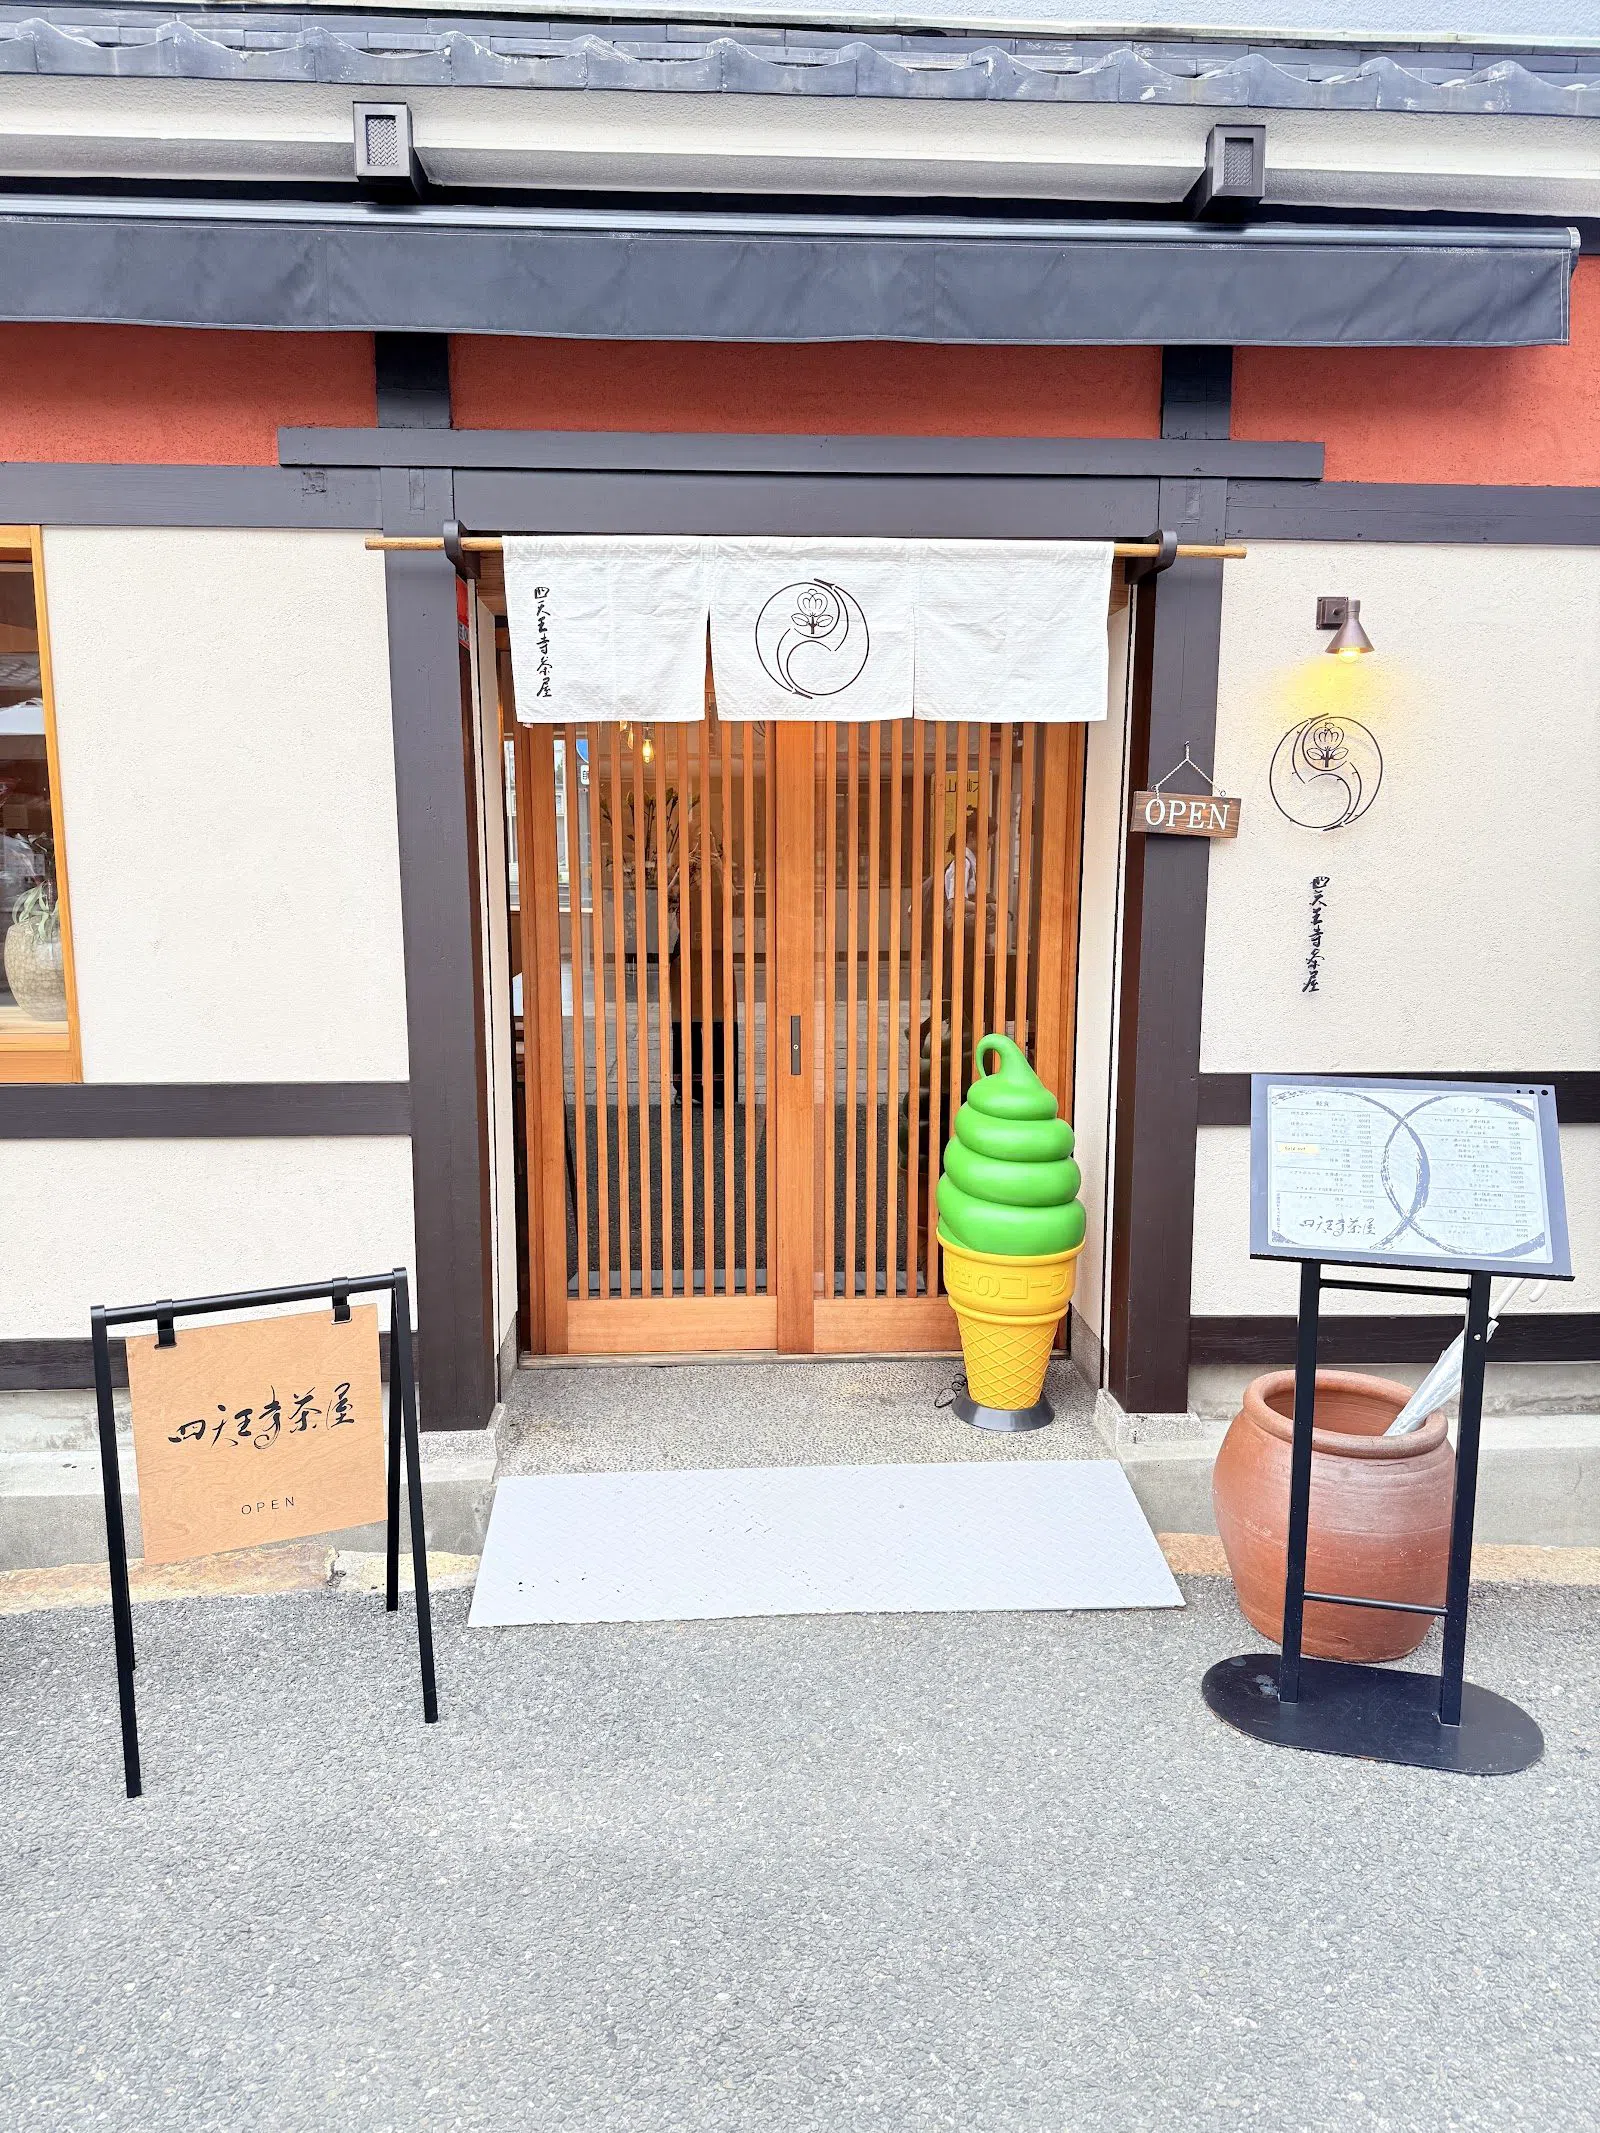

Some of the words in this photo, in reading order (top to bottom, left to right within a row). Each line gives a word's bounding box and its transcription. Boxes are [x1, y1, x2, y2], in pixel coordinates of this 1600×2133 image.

[533, 586, 553, 698] 四天王寺茶屋
[1144, 797, 1231, 831] OPEN
[241, 1496, 296, 1516] OPEN
